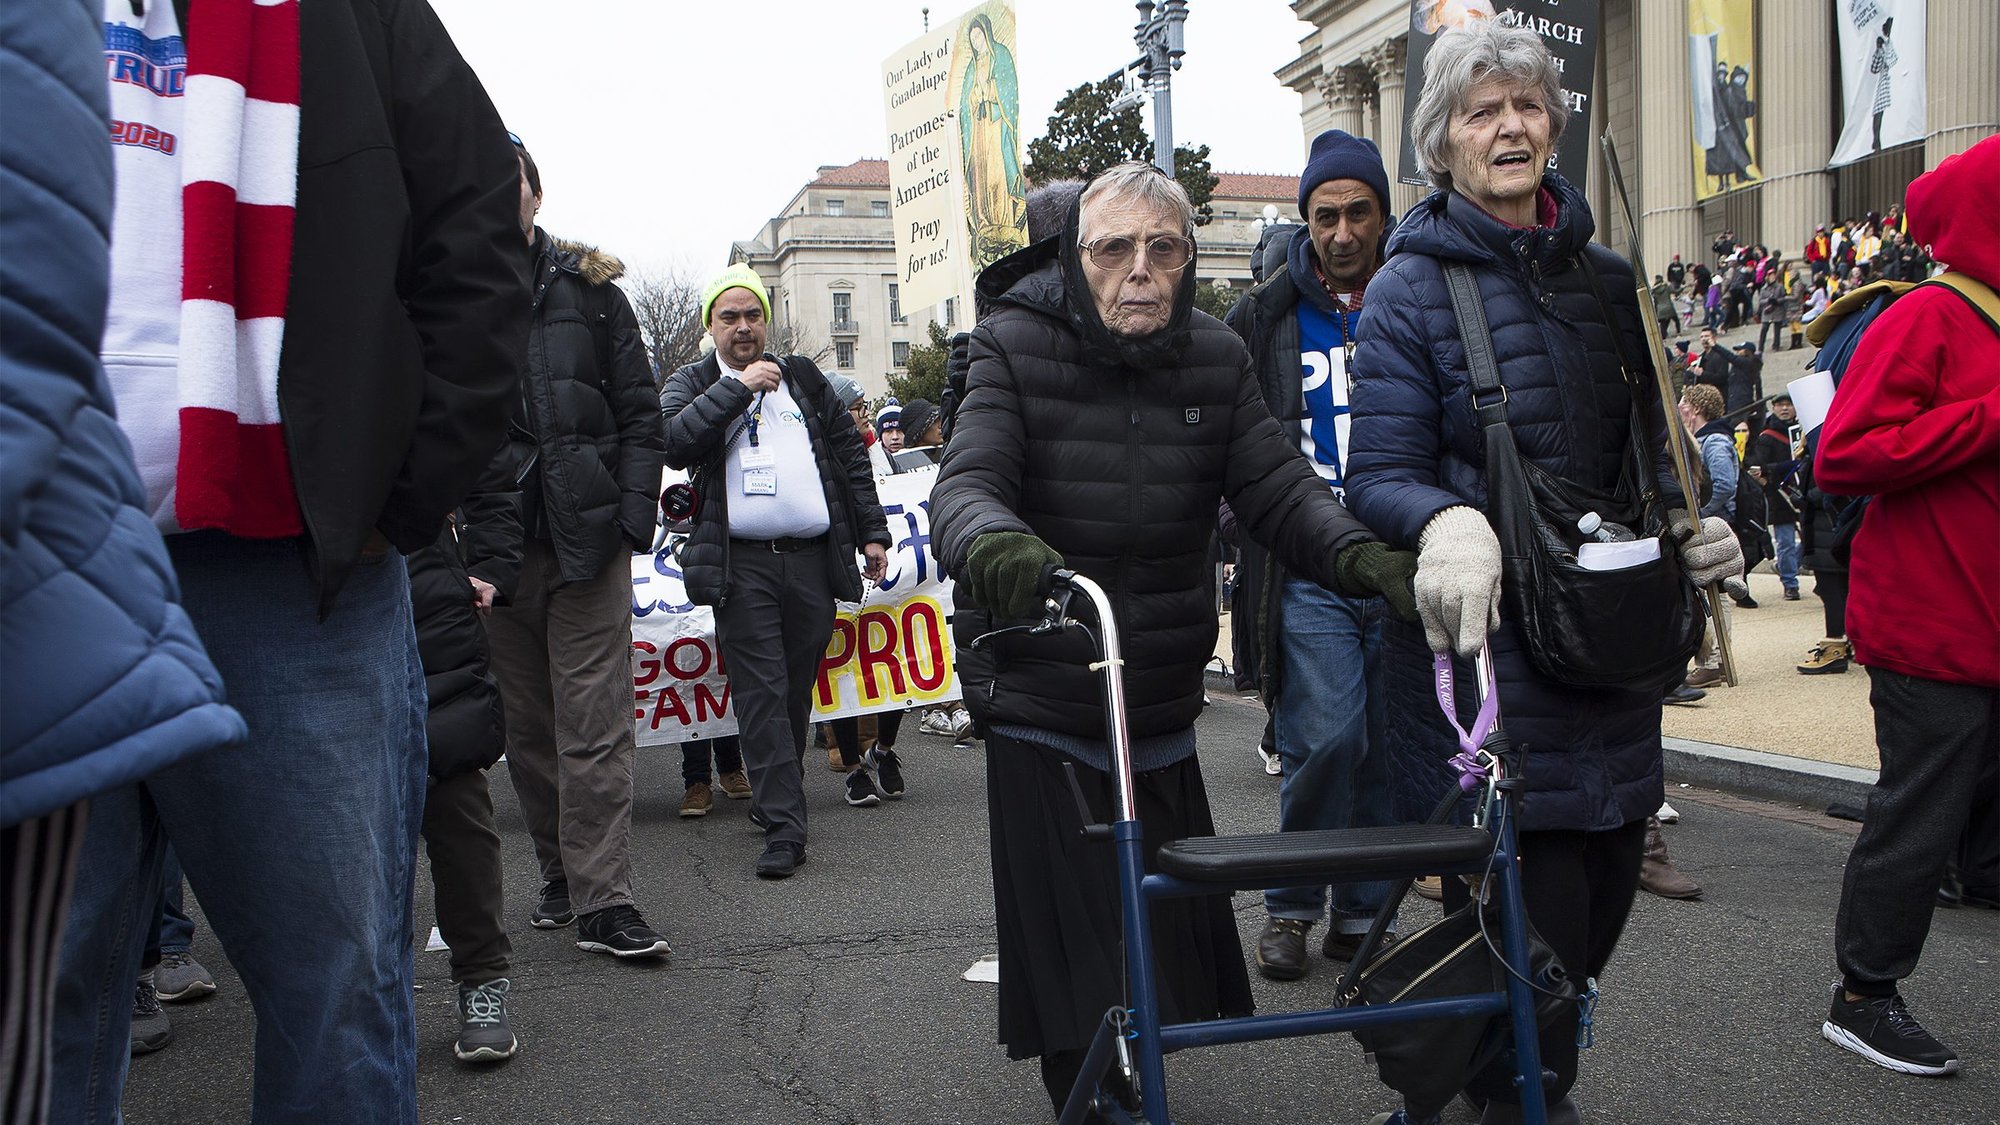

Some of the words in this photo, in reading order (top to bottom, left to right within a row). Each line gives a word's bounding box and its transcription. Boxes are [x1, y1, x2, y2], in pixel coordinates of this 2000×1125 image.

[1501, 8, 1584, 45] MARCH
[886, 69, 904, 88] Our
[906, 50, 933, 76] Lady
[936, 38, 950, 59] of
[891, 70, 947, 109] Guadalupe
[111, 120, 178, 156] 2020
[907, 151, 919, 173] of
[921, 146, 940, 165] the
[911, 218, 941, 244] Pray
[906, 253, 926, 283] for
[930, 238, 949, 266] us!
[816, 602, 946, 707] PRO
[1439, 668, 1451, 691] MIX
